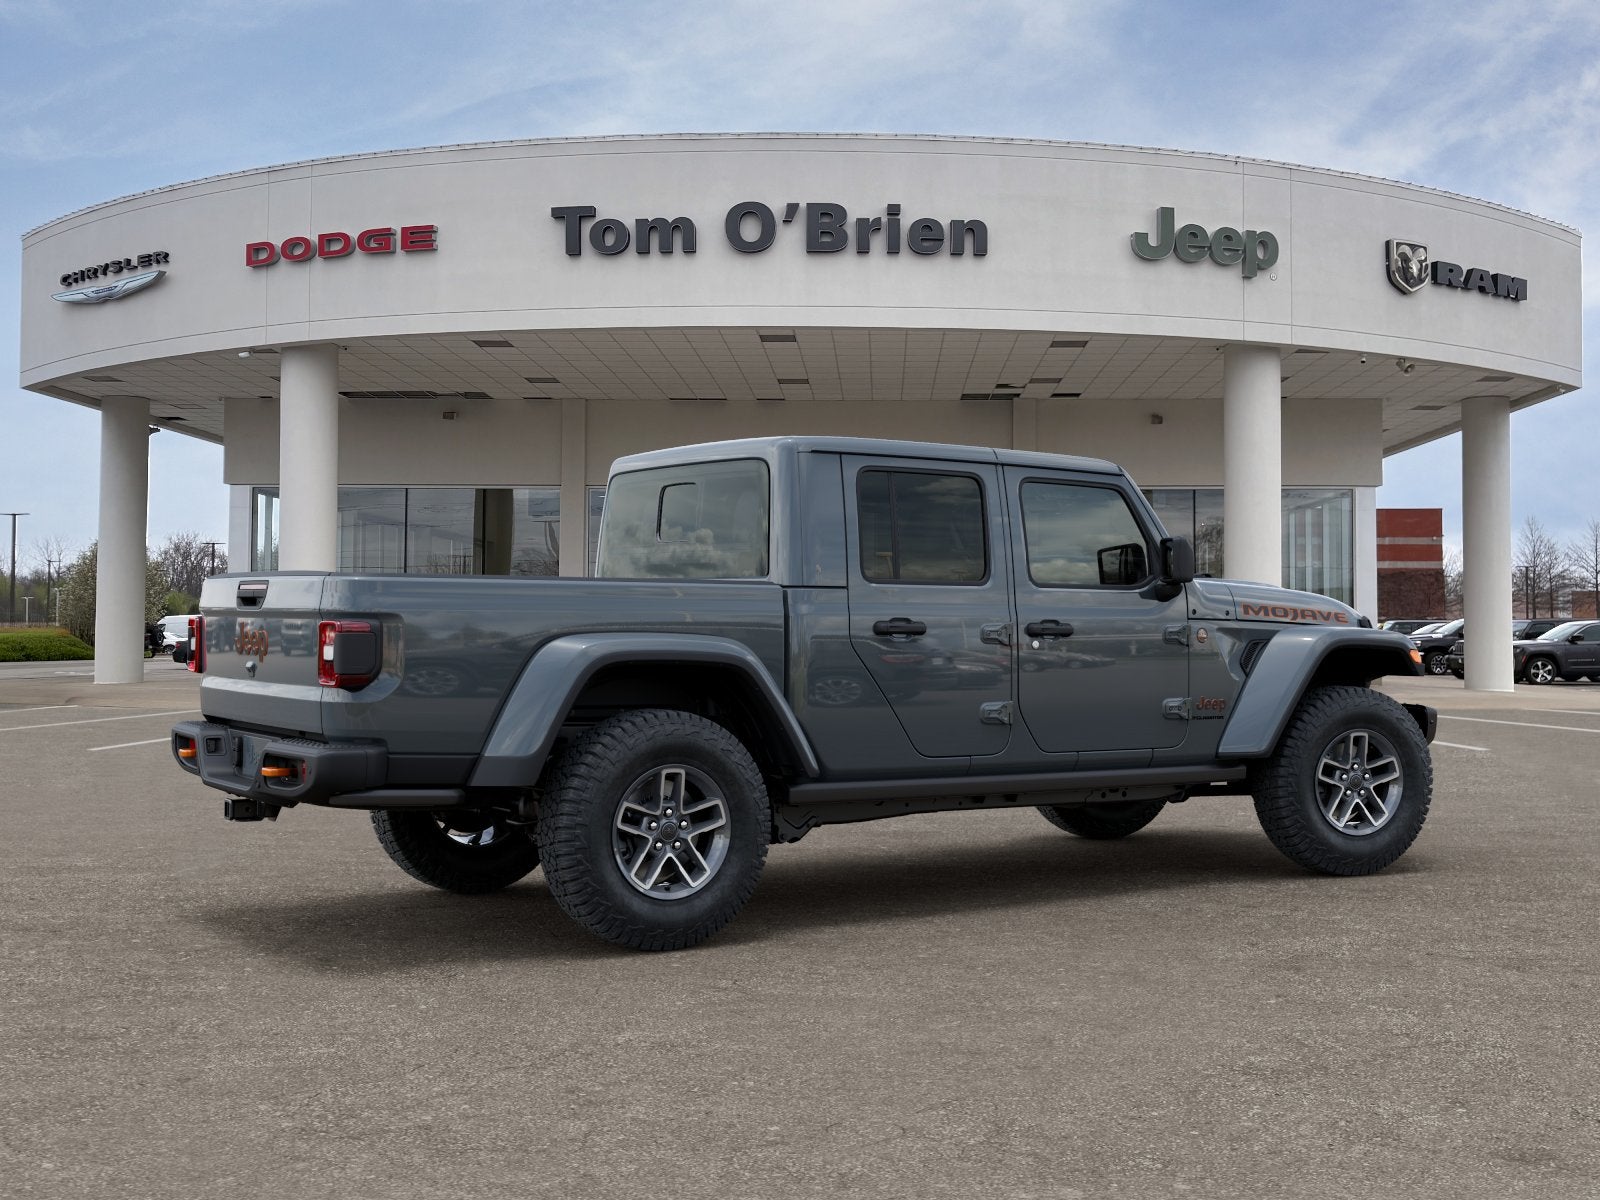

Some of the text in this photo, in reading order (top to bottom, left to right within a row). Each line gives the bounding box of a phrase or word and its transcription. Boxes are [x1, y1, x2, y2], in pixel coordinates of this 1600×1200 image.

[246, 224, 438, 267] DODGE
[551, 201, 988, 256] Tom O'Brien
[1131, 207, 1279, 278] Jeep
[60, 251, 170, 287] CHRYSLER
[1431, 260, 1527, 301] RAM
[1241, 603, 1349, 624] MOJAVE
[234, 621, 269, 663] Jeep
[1196, 695, 1226, 713] Jeep
